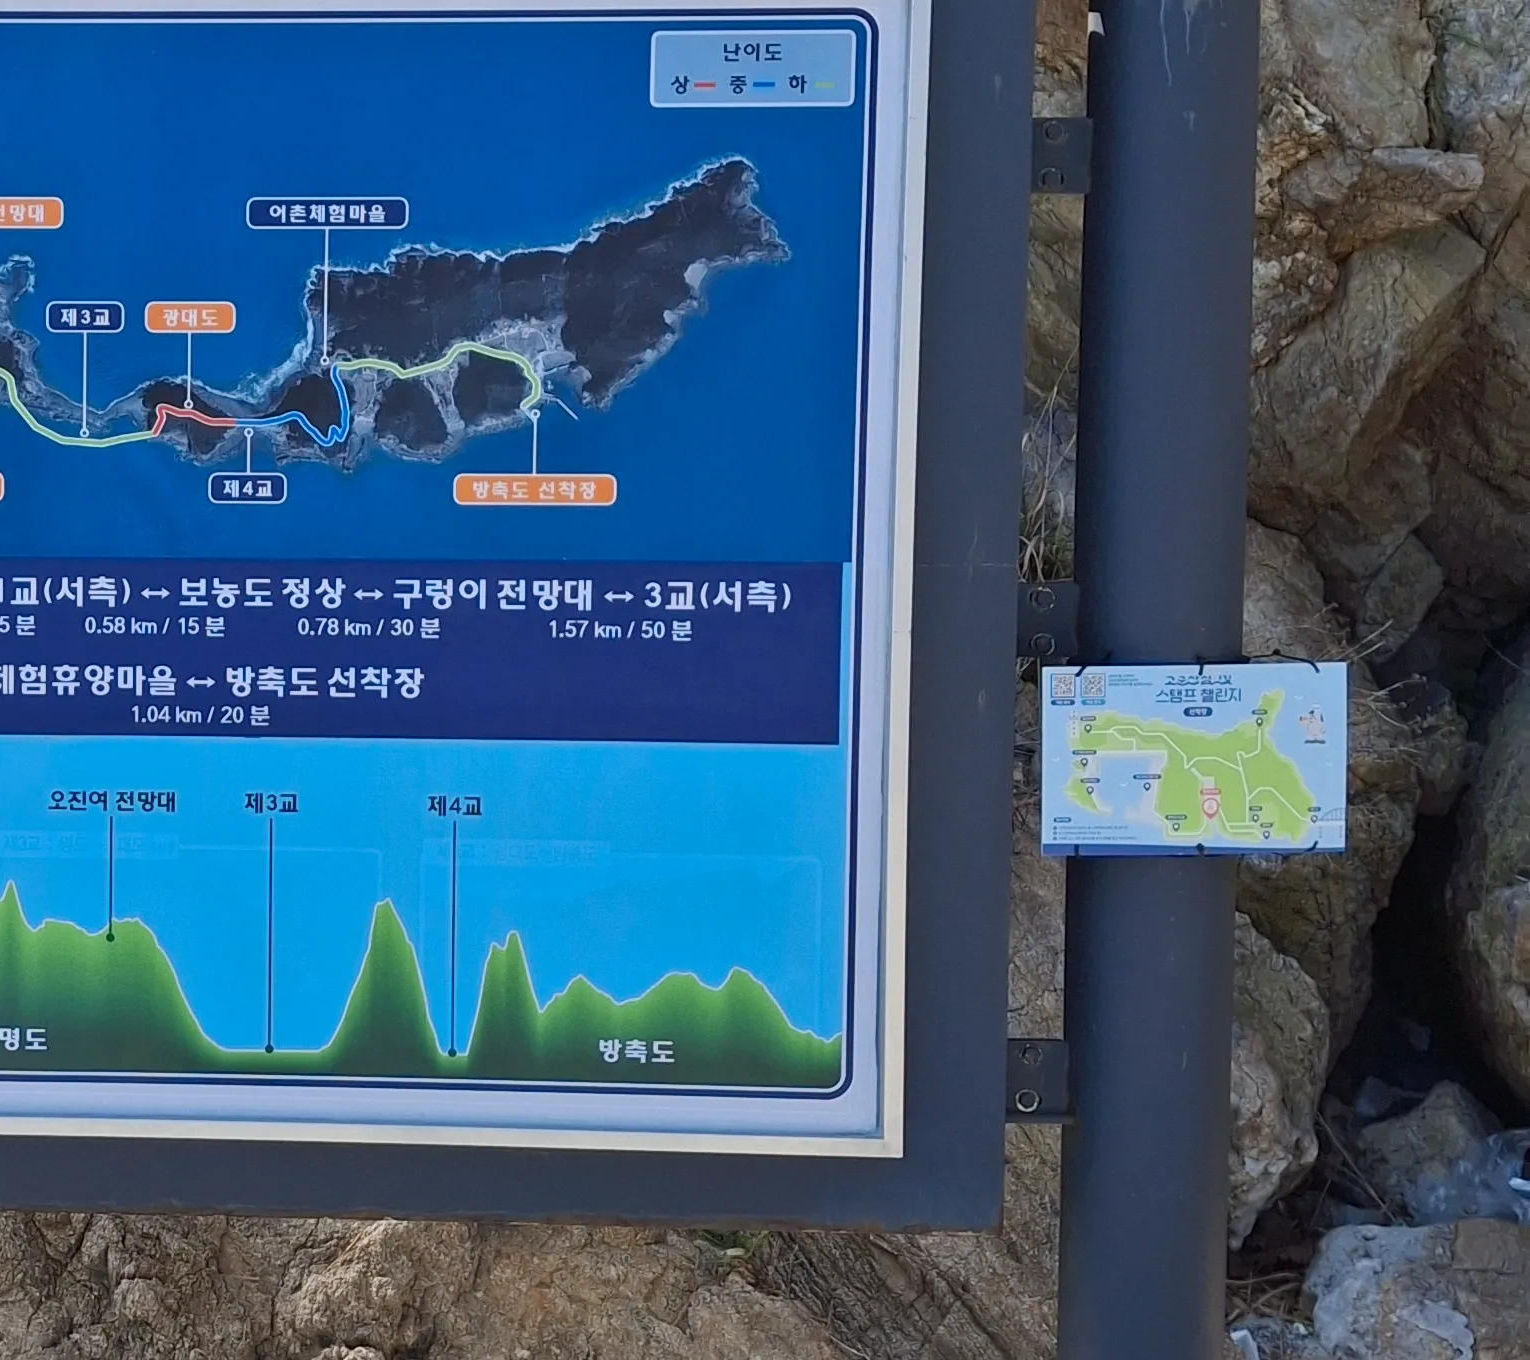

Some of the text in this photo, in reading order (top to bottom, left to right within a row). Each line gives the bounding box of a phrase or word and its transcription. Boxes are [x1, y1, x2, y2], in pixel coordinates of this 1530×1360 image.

[724, 43, 782, 61] 난이도
[671, 76, 690, 94] 상
[730, 76, 747, 94] 중
[789, 75, 807, 93] 하
[270, 204, 385, 223] 어촌체험마을
[61, 309, 110, 326] 제3교
[160, 308, 221, 327] 광대도
[223, 480, 272, 497] 제4교
[471, 479, 598, 503] 방축도 선착장
[179, 578, 273, 608] 보농도
[282, 578, 346, 608] 정상
[393, 579, 486, 609] 구렁이
[497, 580, 592, 611] 전망대
[645, 581, 790, 612] 3교(서측)
[16, 615, 35, 635] 분
[85, 617, 225, 636] 0.58 km / 15 분
[298, 618, 440, 638] 0.78 km / 30 분
[550, 620, 692, 641] 1.57 km / 50 분
[227, 666, 318, 697] 방축도
[328, 667, 424, 698] 선착장
[1155, 688, 1241, 703] 스탬프 챌린지
[132, 706, 270, 725] 1.04 km / 20 분
[48, 789, 176, 813] 오진여 전망대
[245, 792, 298, 813] 제3교
[428, 796, 482, 816] 제4교
[599, 1039, 675, 1064] 방축도
